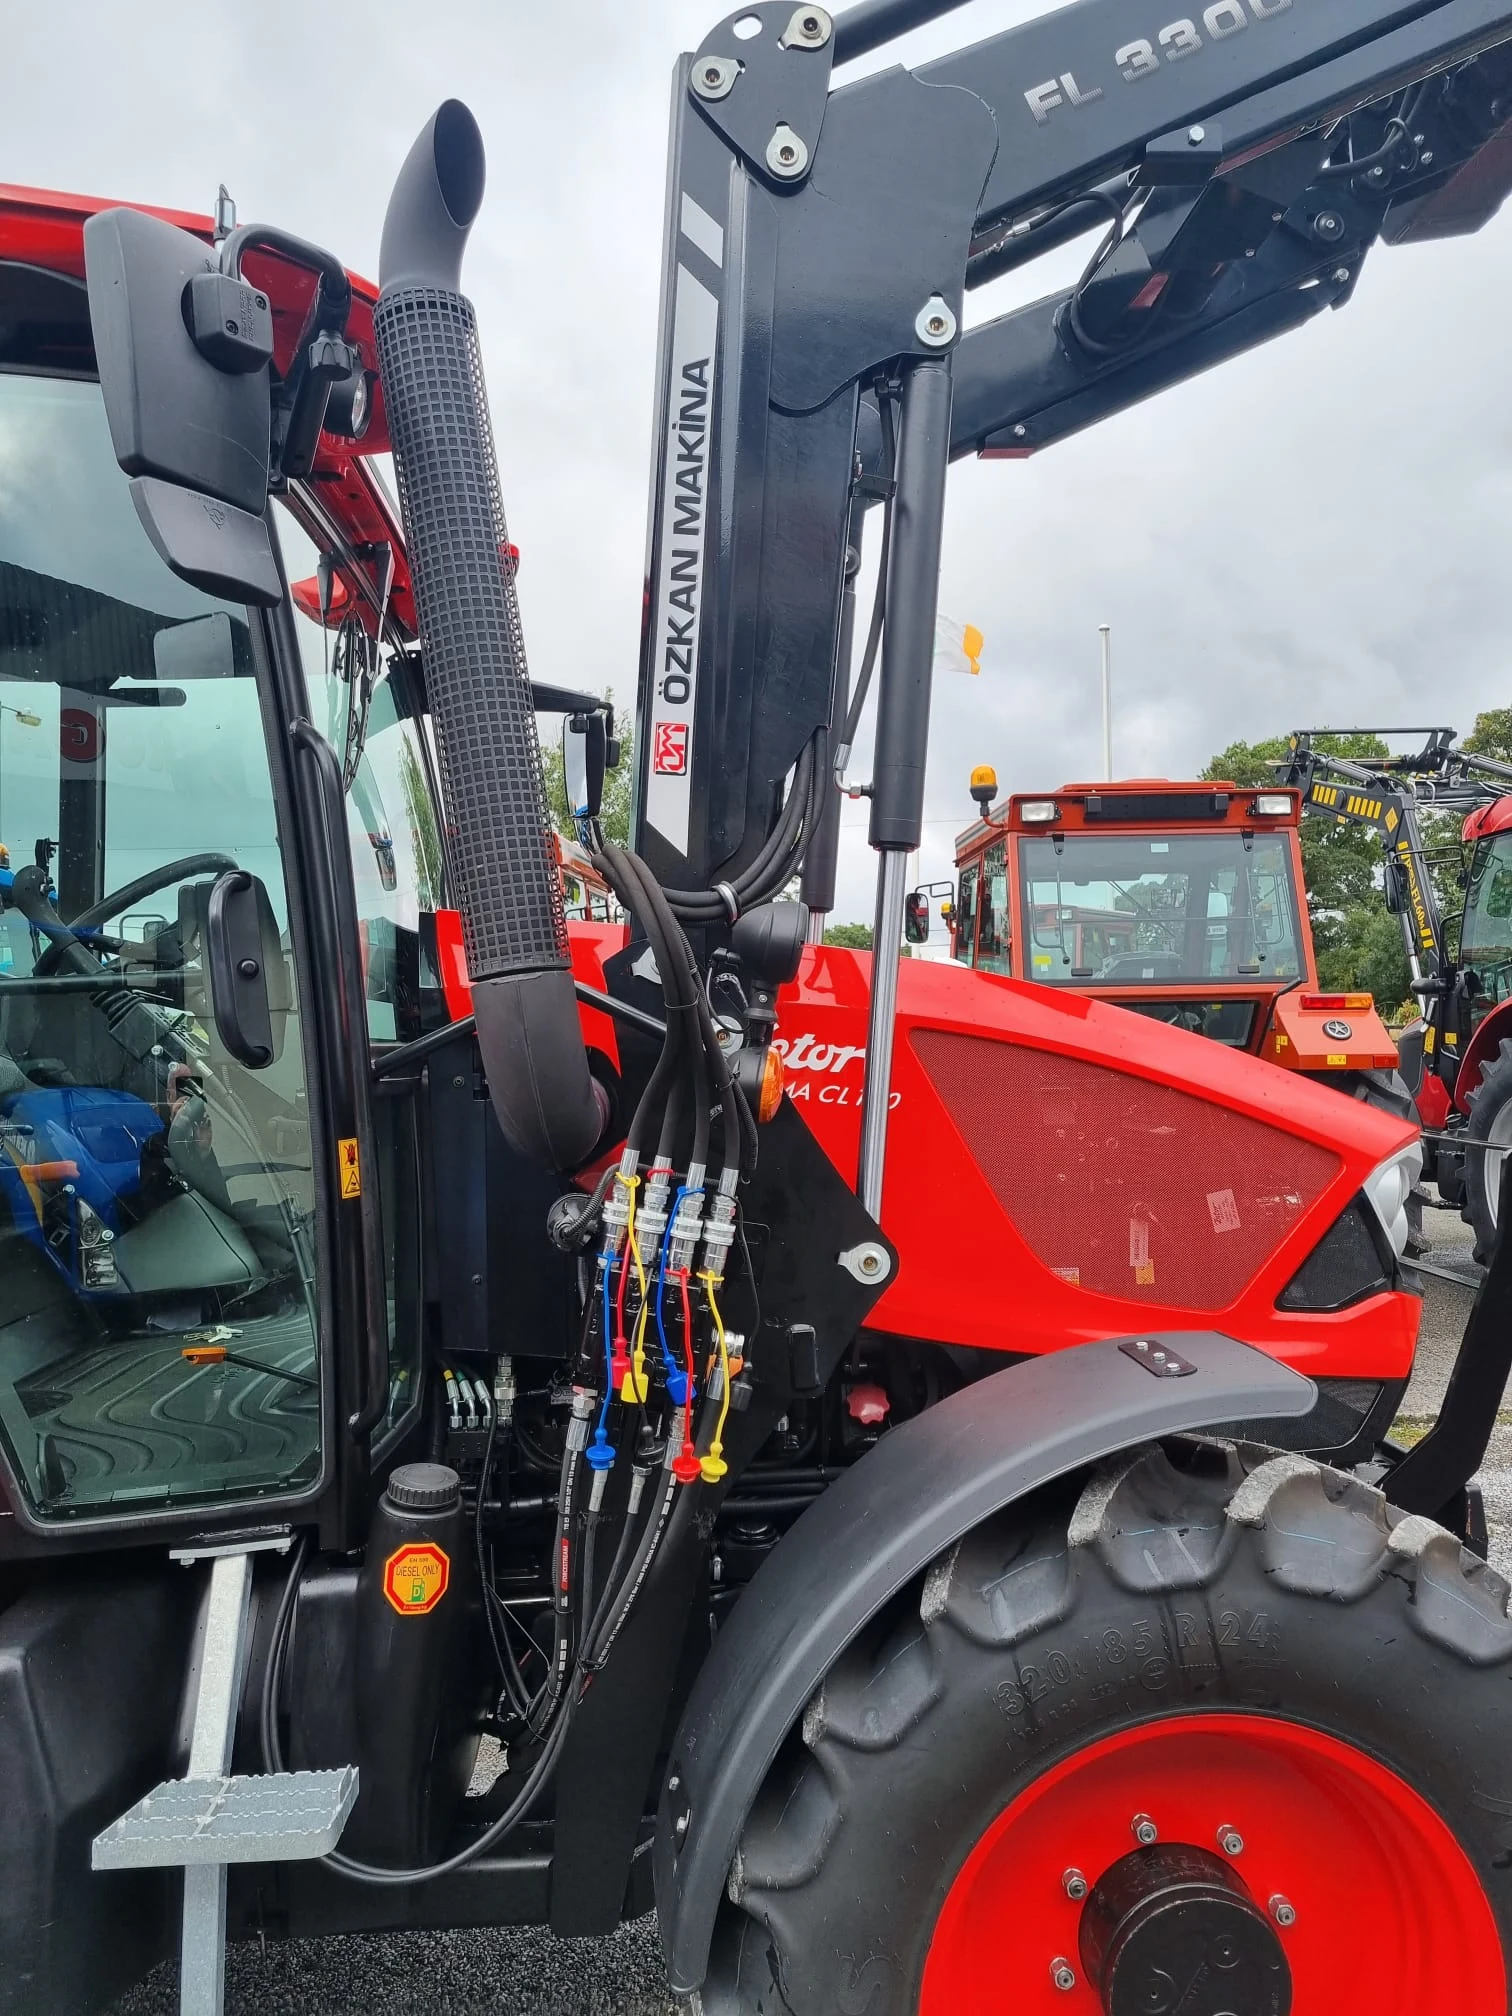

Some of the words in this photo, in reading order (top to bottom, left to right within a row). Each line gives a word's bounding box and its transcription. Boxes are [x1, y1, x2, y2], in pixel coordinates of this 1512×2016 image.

[1023, 71, 1104, 126] FL
[672, 357, 710, 536] MAKİNA
[658, 549, 699, 705] ÖZKAN
[773, 1023, 867, 1073] etor
[819, 1085, 849, 1105] CL
[396, 1565, 421, 1577] DIESEL
[422, 1563, 440, 1577] ONLY
[1218, 1611, 1273, 1649] 24
